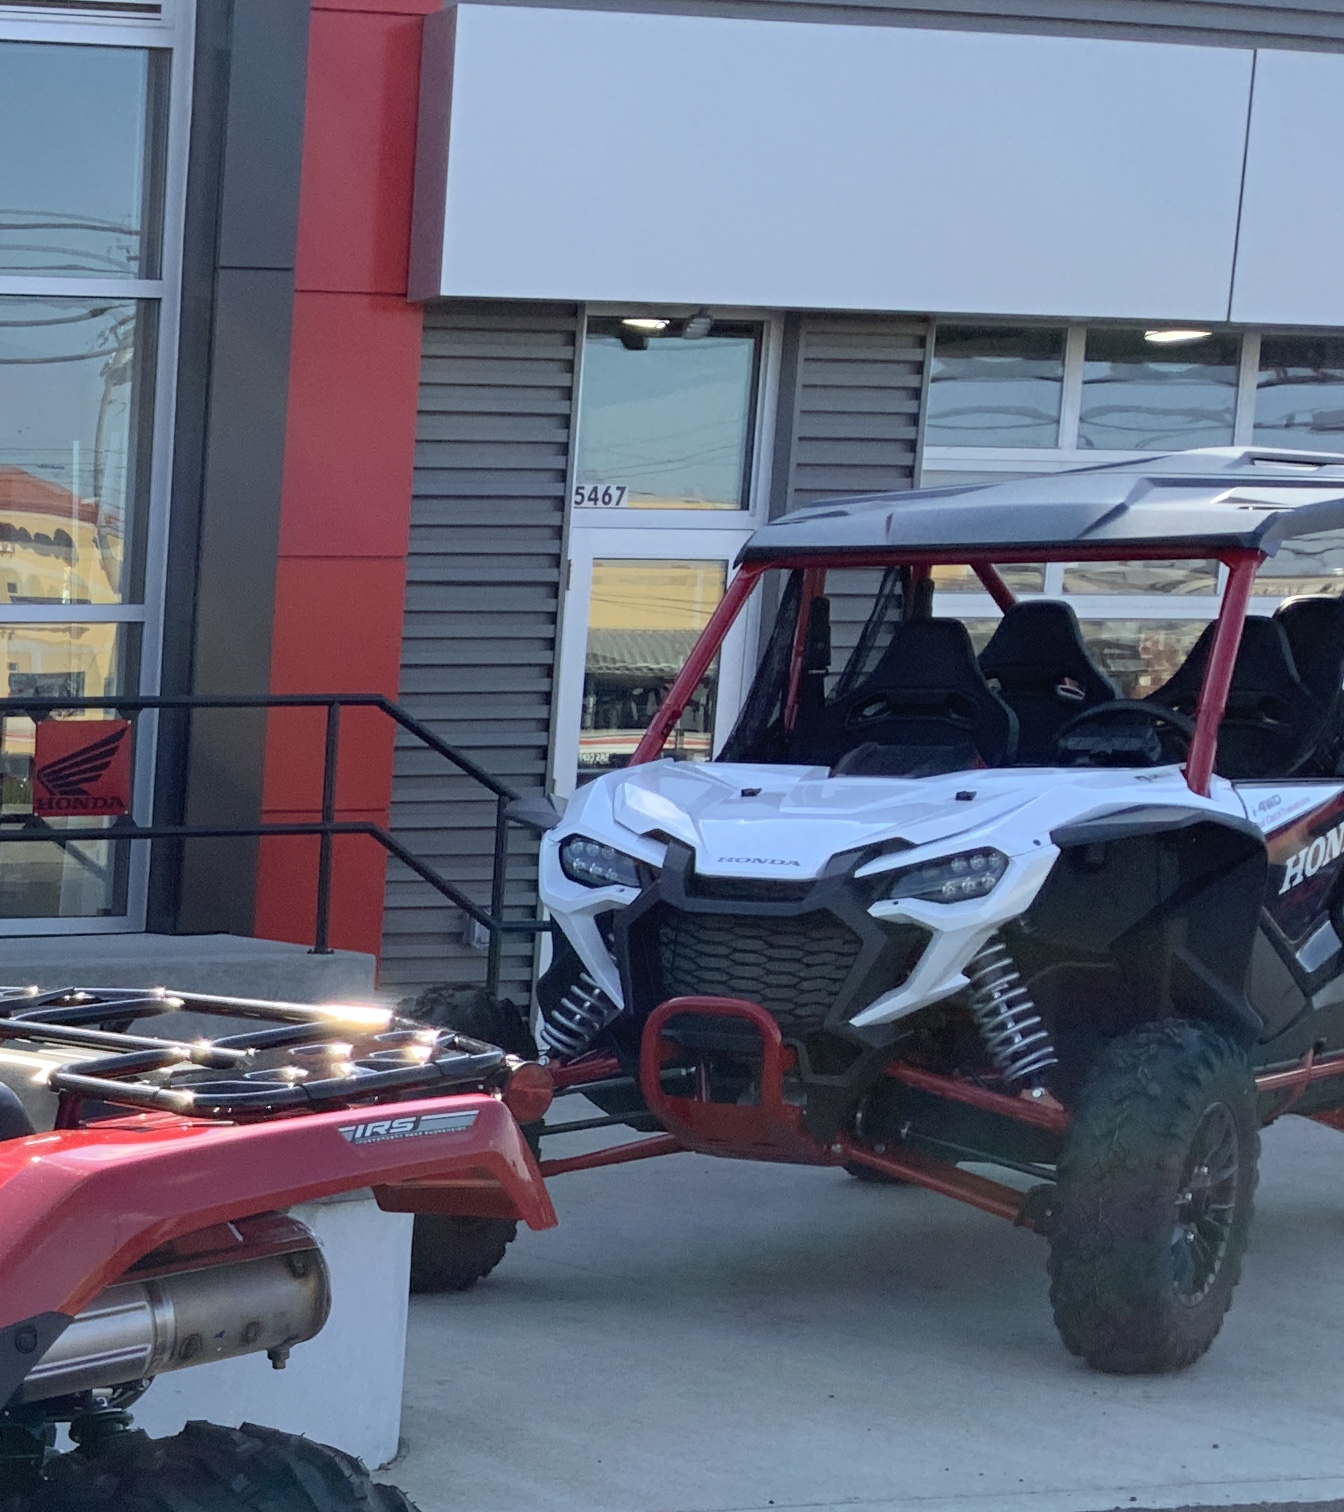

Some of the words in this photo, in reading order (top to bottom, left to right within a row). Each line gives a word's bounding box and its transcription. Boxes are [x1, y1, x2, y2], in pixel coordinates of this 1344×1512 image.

[574, 486, 626, 506] 5467
[36, 796, 126, 811] HONDA
[717, 857, 801, 867] HONDA
[355, 1116, 417, 1139] IRS
